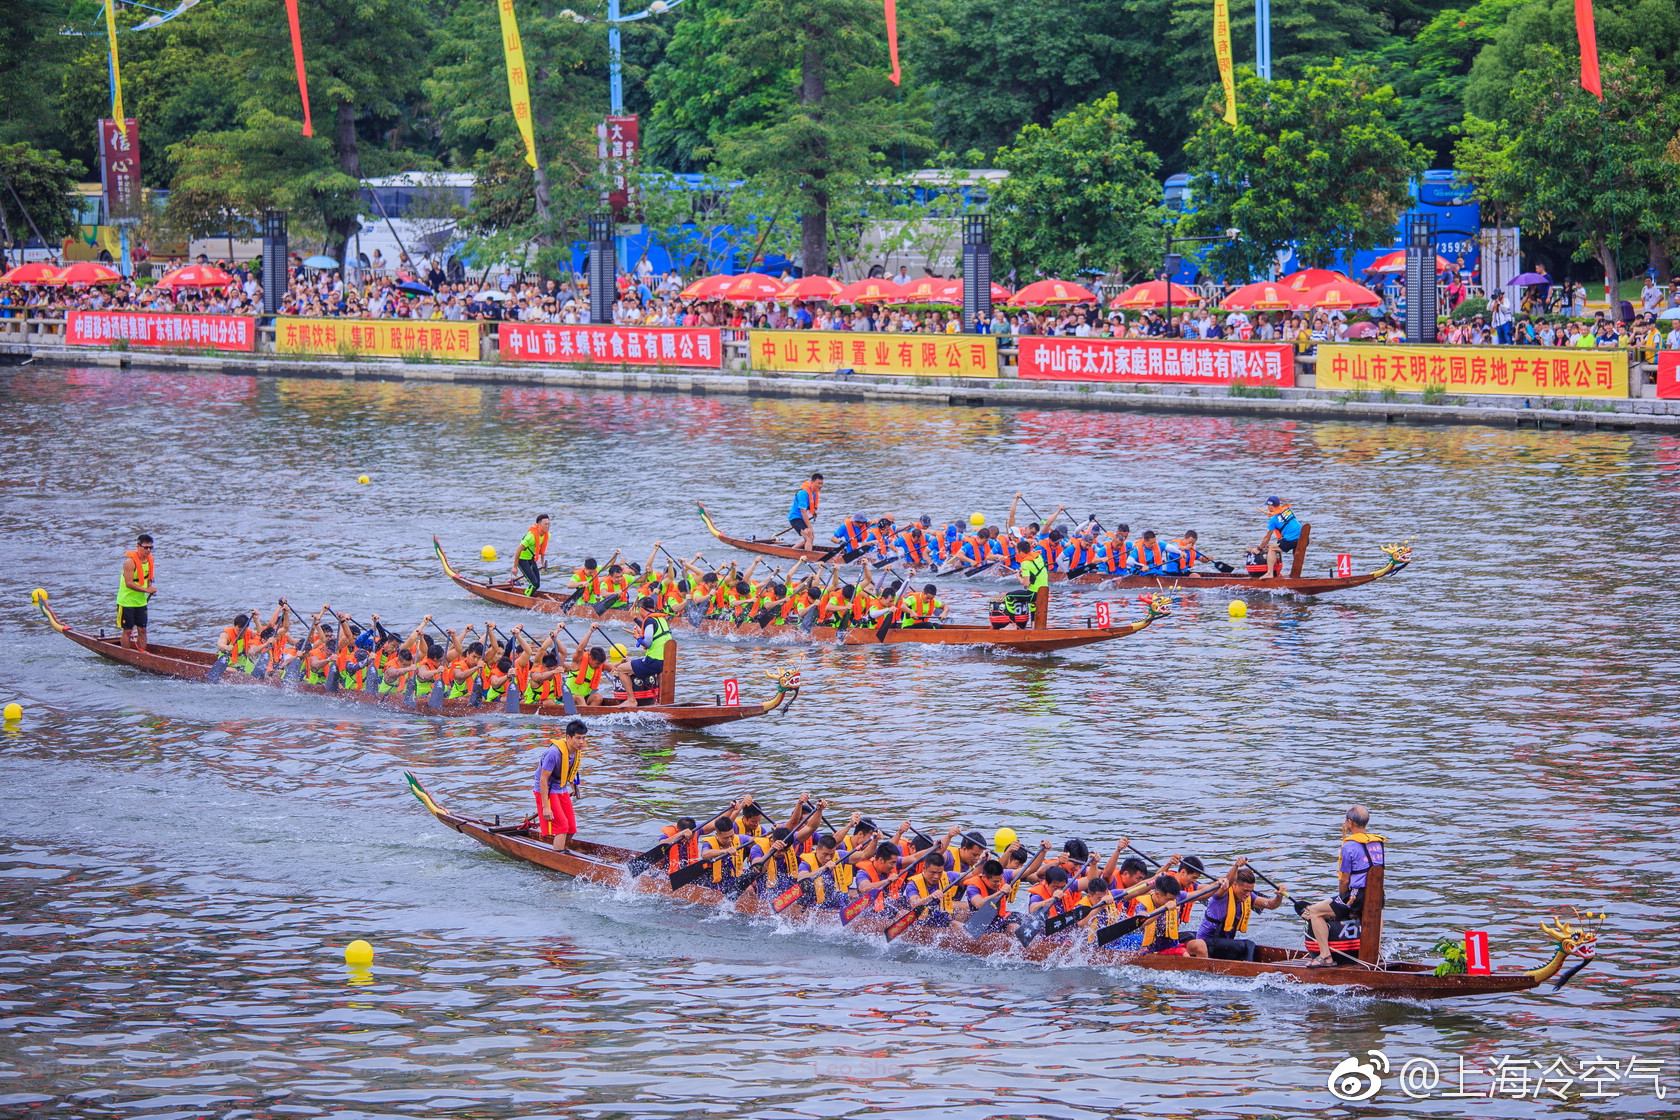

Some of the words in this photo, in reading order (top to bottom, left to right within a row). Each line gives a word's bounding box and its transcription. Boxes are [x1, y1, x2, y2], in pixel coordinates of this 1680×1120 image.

[74, 315, 246, 345] 中国移动通信集团广东有限公司中山分公司
[762, 337, 987, 370] 中山天润置业有限公司
[1034, 344, 1282, 379] 中山市太力家庭用品制造有限公司
[1331, 352, 1613, 390] 中山市天明花园房地产有限公司
[1339, 555, 1350, 575] 4
[1098, 604, 1109, 626] 3
[726, 681, 738, 706] 2
[1469, 934, 1486, 970] 1
